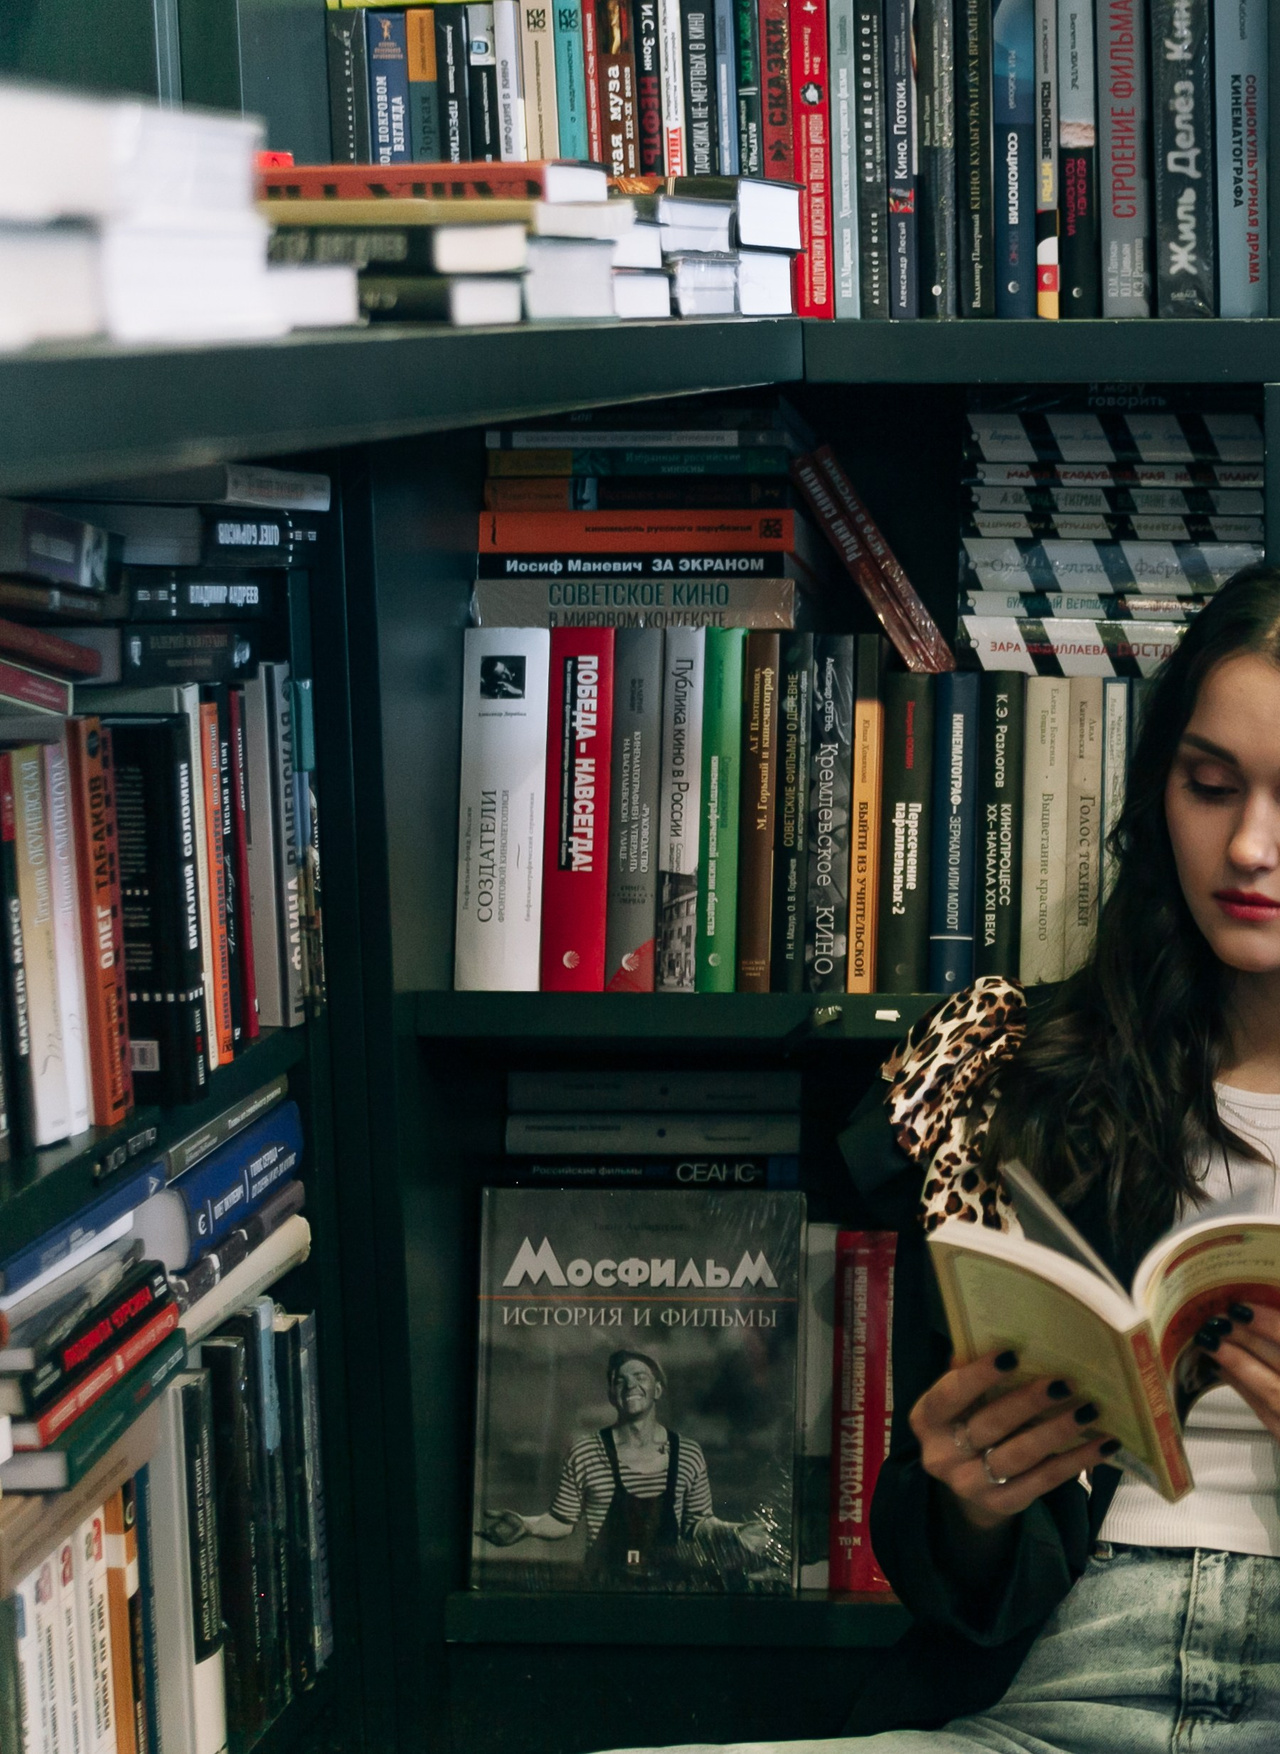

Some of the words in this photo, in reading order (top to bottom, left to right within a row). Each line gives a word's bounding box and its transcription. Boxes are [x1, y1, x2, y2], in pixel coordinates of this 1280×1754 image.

[643, 38, 655, 70] Зонн
[687, 13, 705, 39] КИНО
[1110, 0, 1133, 98] ФИЛЬМА
[608, 65, 623, 120] муза
[689, 54, 708, 119] НЕ-МЕРТВЫХ
[765, 20, 788, 126] СКАЗКИ
[893, 78, 908, 135] Потоки.
[895, 138, 908, 179] Кино.
[1110, 107, 1136, 218] СТРОЕНИЕ
[1231, 74, 1244, 208] КИНЕМАТОГРАФА
[1243, 74, 1259, 227] СОЦИОКУЛЬТУРНАЯ
[1006, 133, 1018, 224] СОЦИОЛОГИЯ
[1169, 188, 1198, 275] Жиль
[1247, 232, 1259, 284] ДРАМА
[505, 558, 564, 574] Иосиф
[568, 559, 643, 573] Маневич
[652, 559, 674, 572] ЗА
[679, 559, 765, 573] ЭКРАНОМ
[548, 584, 665, 607] СОВЕТСКОЕ
[672, 584, 729, 607] КИНО
[548, 612, 559, 627] В
[562, 611, 639, 628] МИРОВОМ
[644, 612, 726, 629] КОНТЕКСТЕ
[571, 656, 598, 739] ПОБЕДА
[671, 660, 693, 725] Публика
[995, 694, 1008, 721] К.Э.
[671, 728, 689, 766] кино
[672, 769, 684, 778] в
[995, 726, 1007, 788] Разлогов
[179, 762, 193, 857] СОЛОМИН
[569, 758, 596, 872] НАВСЕГДА!
[671, 781, 690, 837] России
[816, 742, 839, 887] Кремлевское
[857, 801, 868, 851] ВЫЙТИ
[477, 790, 497, 922] СОЗДАТЕЛИ
[857, 855, 867, 874] ИЗ
[892, 802, 907, 914] параллельных-2
[906, 802, 921, 890] Пересечение
[948, 817, 960, 865] ЗЕРКАЛО
[986, 831, 996, 886] НАЧАЛА
[999, 804, 1011, 906] КИНОПРОЦЕСС
[183, 864, 199, 949] ВИТАЛИЙ
[948, 867, 959, 890] ИЛИ
[11, 900, 23, 963] МАРСО
[815, 905, 834, 974] КИНО
[854, 877, 867, 977] УЧИТЕЛЬСКОЙ
[947, 893, 959, 930] МОЛОТ
[984, 914, 995, 946] ВЕКА
[19, 967, 30, 1055] МАРСЕЛЬ
[502, 1306, 623, 1327] ИСТОРИЯ
[634, 1307, 651, 1326] И
[660, 1307, 776, 1328] ФИЛЬМЫ
[838, 1410, 862, 1523] ХРОНИКА
